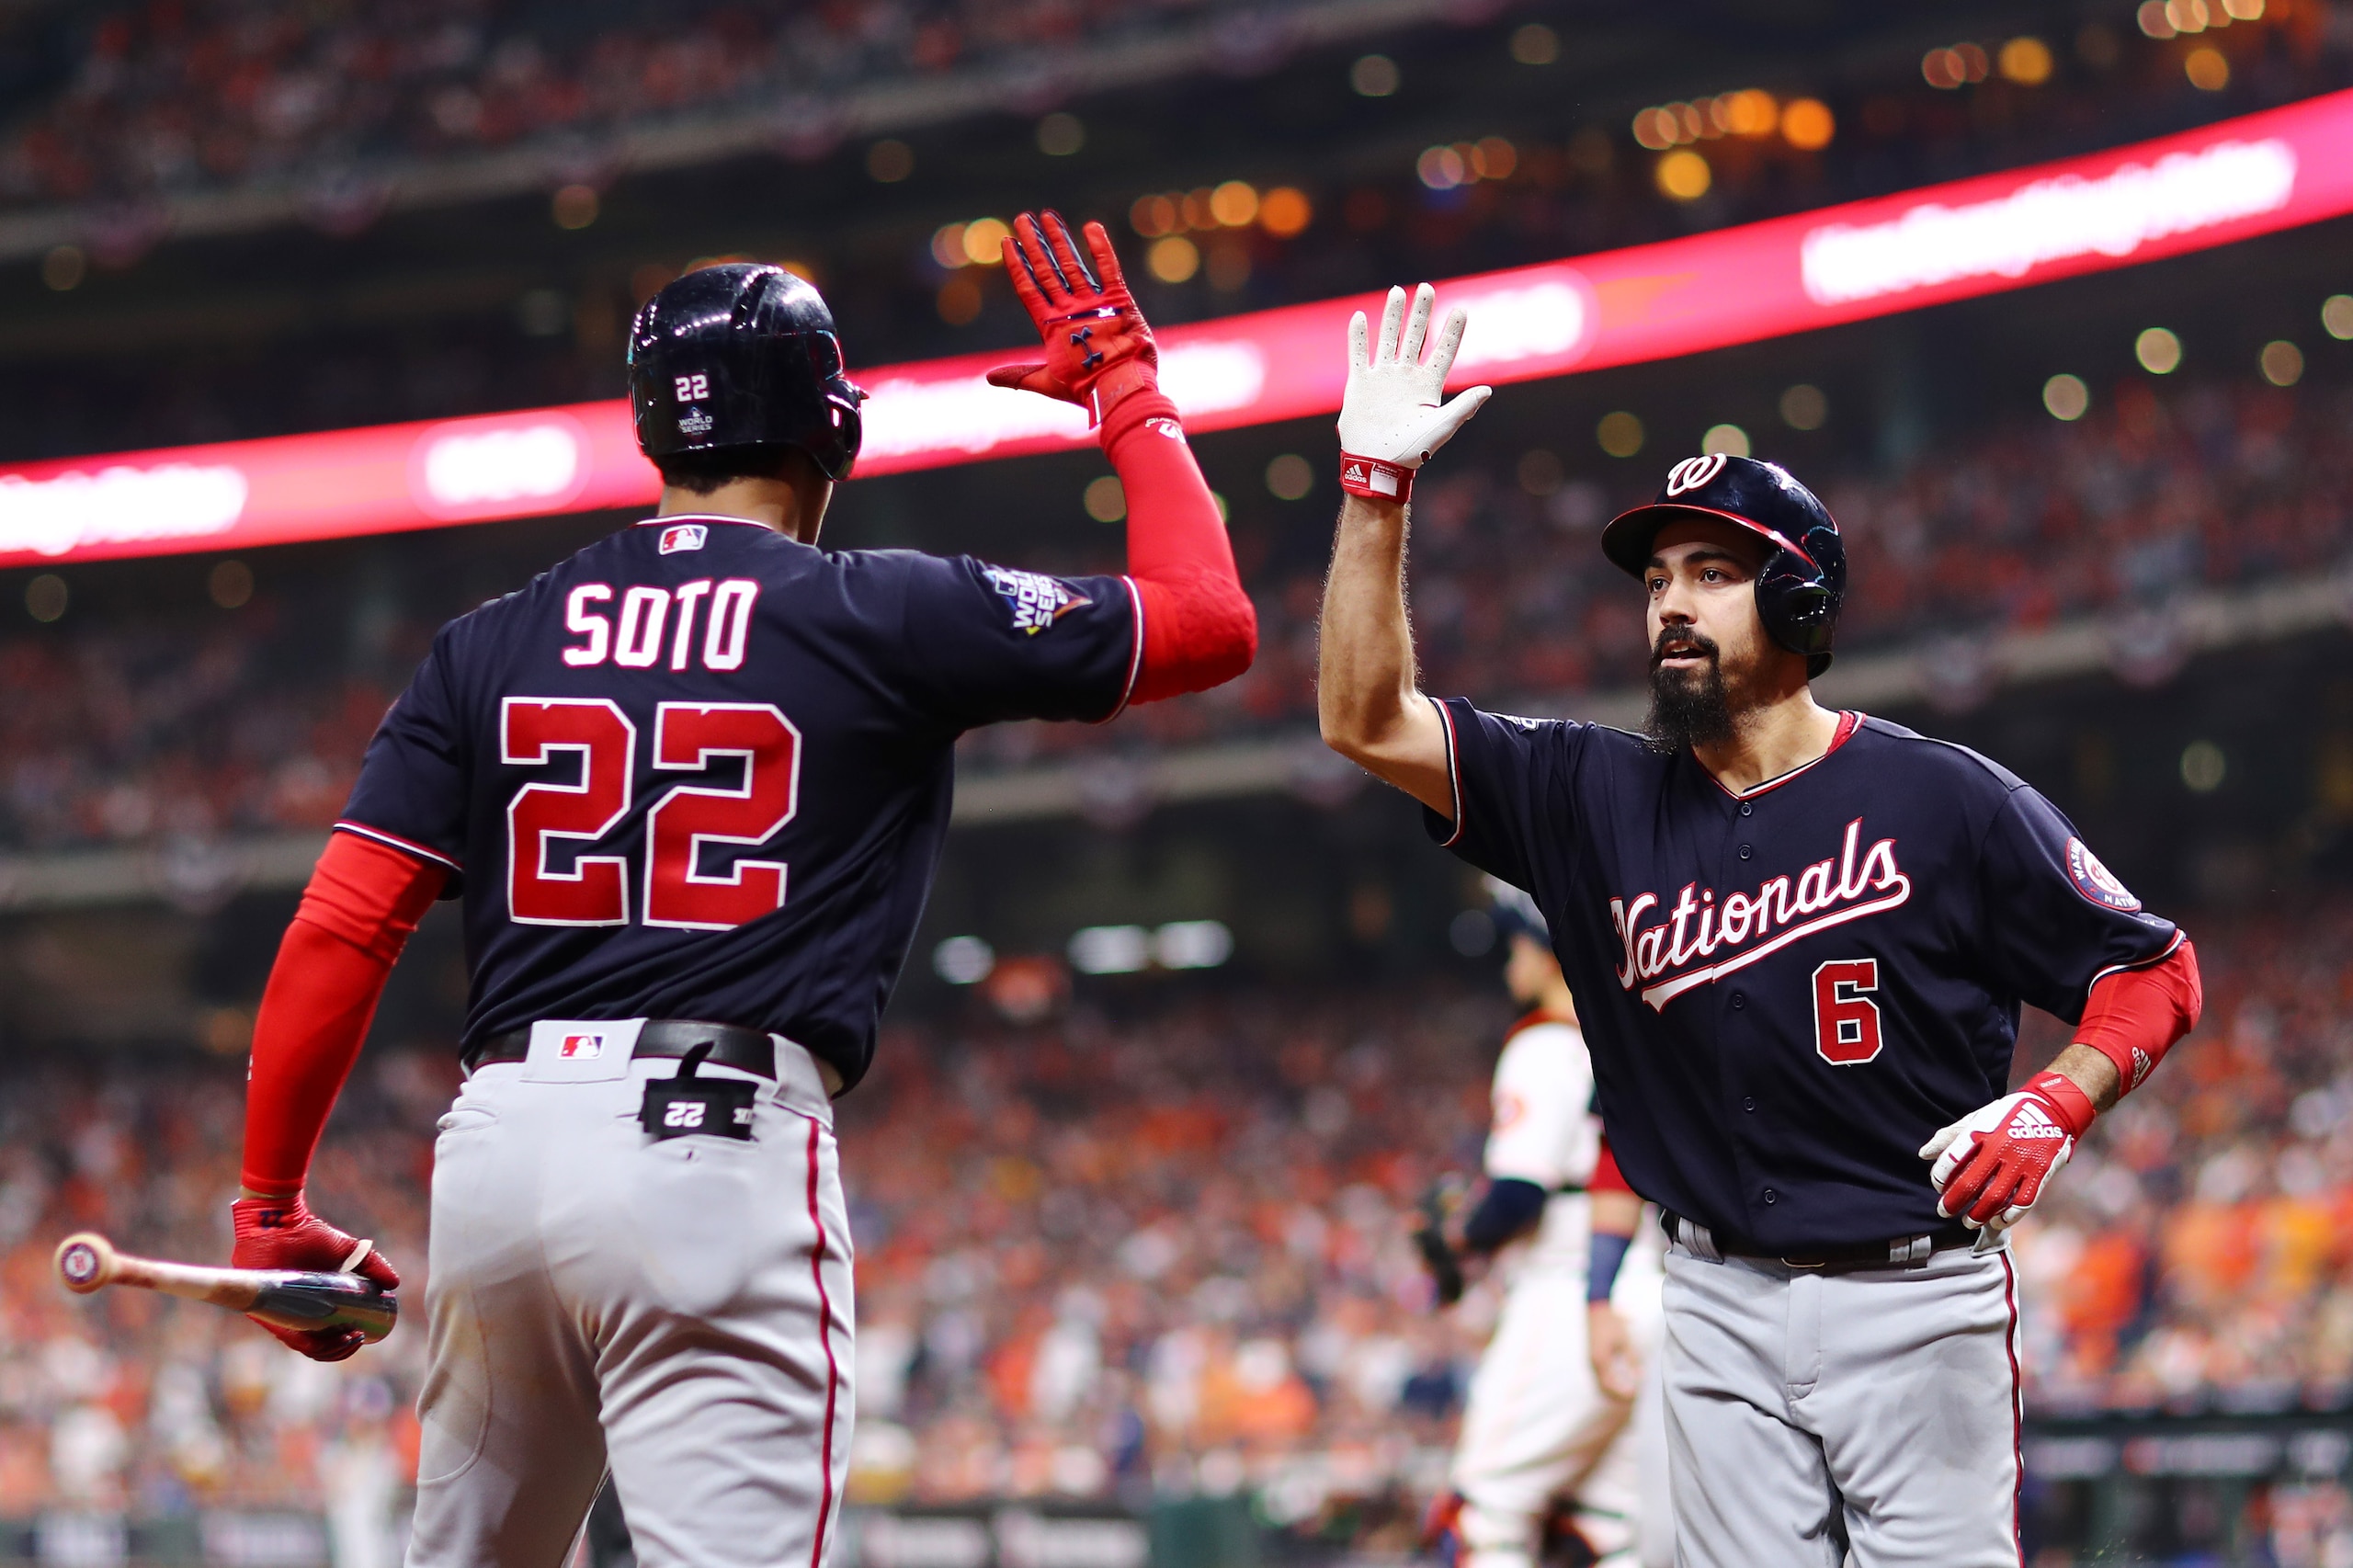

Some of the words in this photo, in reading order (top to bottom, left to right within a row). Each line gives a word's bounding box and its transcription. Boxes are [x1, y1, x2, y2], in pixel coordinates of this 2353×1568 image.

[675, 374, 709, 402] 22
[677, 415, 713, 426] WORLD
[680, 424, 712, 434] SERIES
[1344, 472, 1368, 484] adidas
[1666, 452, 1727, 499] W
[562, 578, 758, 671] SOTO
[500, 696, 802, 932] 22
[1609, 816, 1910, 991] Nationals
[1812, 958, 1883, 1066] 6
[664, 1101, 707, 1128] 22
[2006, 1123, 2064, 1140] adidas
